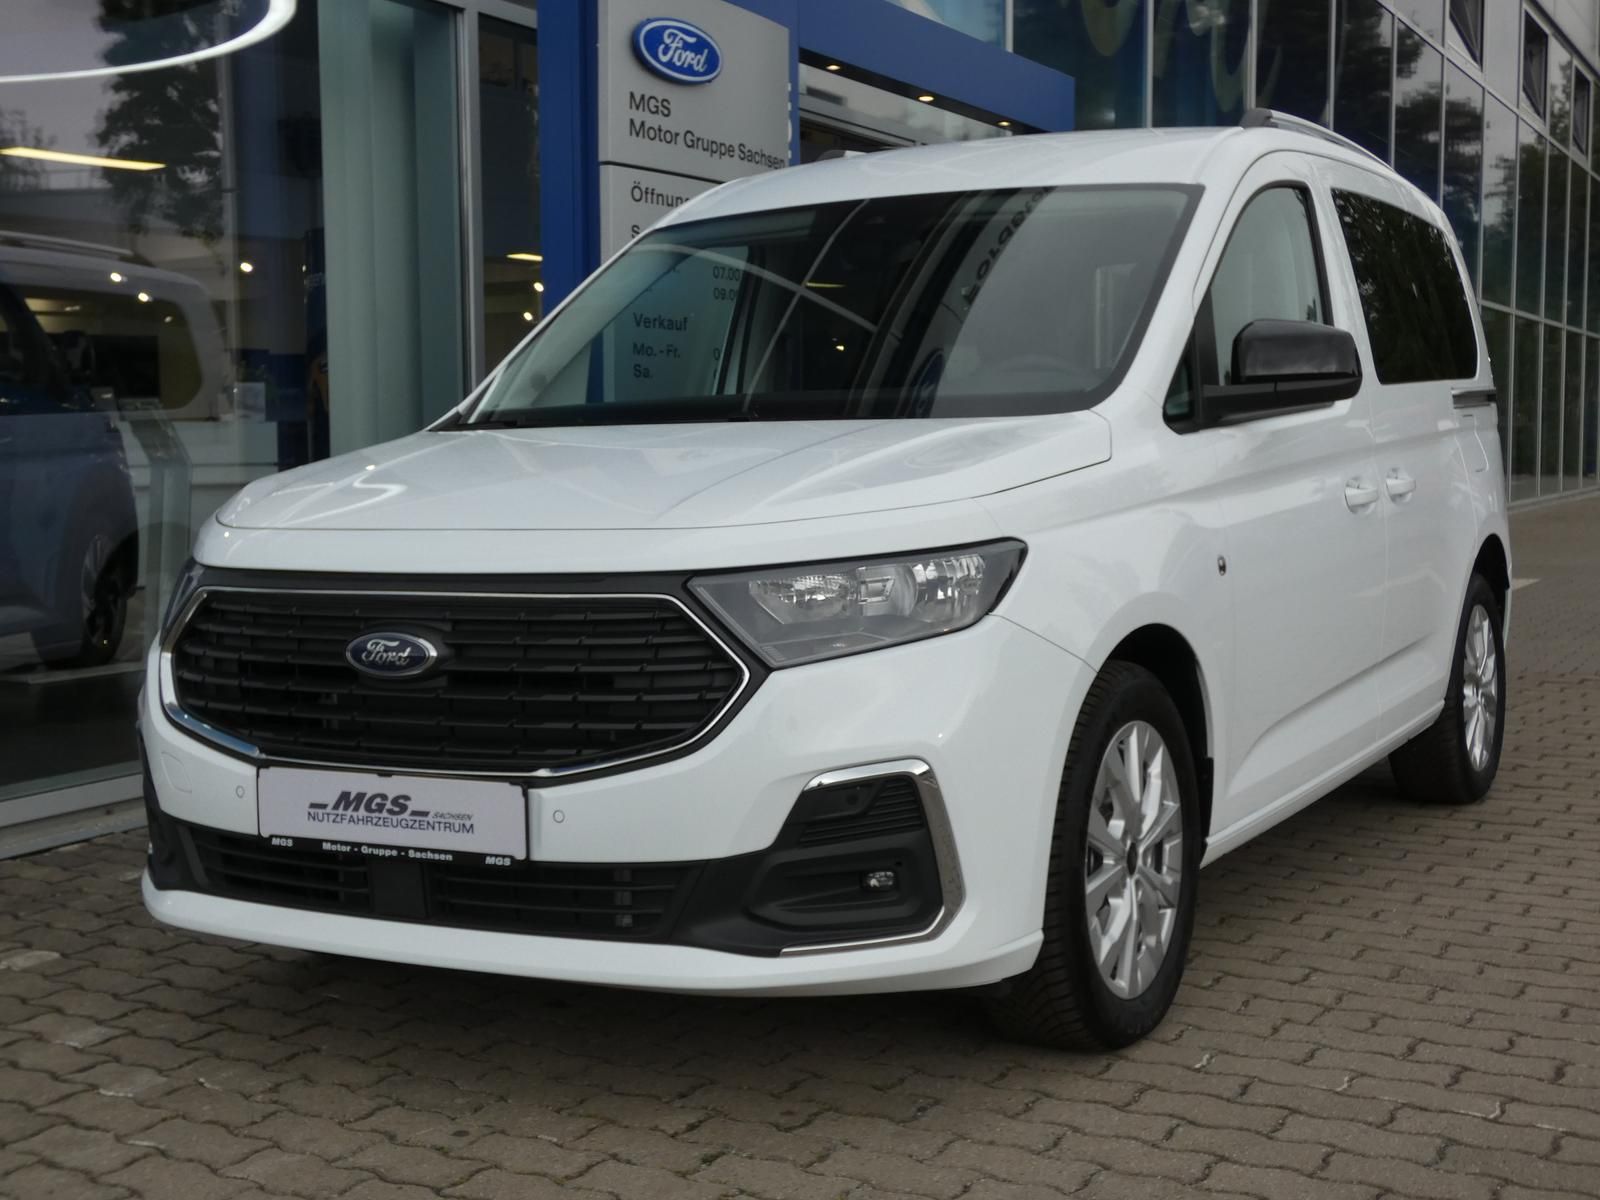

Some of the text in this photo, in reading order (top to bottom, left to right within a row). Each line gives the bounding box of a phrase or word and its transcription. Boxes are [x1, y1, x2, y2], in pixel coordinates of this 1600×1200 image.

[658, 28, 708, 72] Ford
[629, 91, 671, 118] MGS
[629, 118, 785, 170] Motor Gruppe Sachsen
[631, 180, 690, 207] Öffnun
[713, 287, 737, 301] 09.0
[632, 312, 688, 331] Verkauf
[361, 639, 411, 666] Ford
[307, 811, 474, 834] NUTZFAHRZEUGZENTRUM
[271, 837, 293, 847] MGS
[322, 842, 351, 852] Motor
[361, 845, 398, 857] Gruppe
[408, 849, 453, 861] Sachsen
[485, 856, 511, 866] MGS
